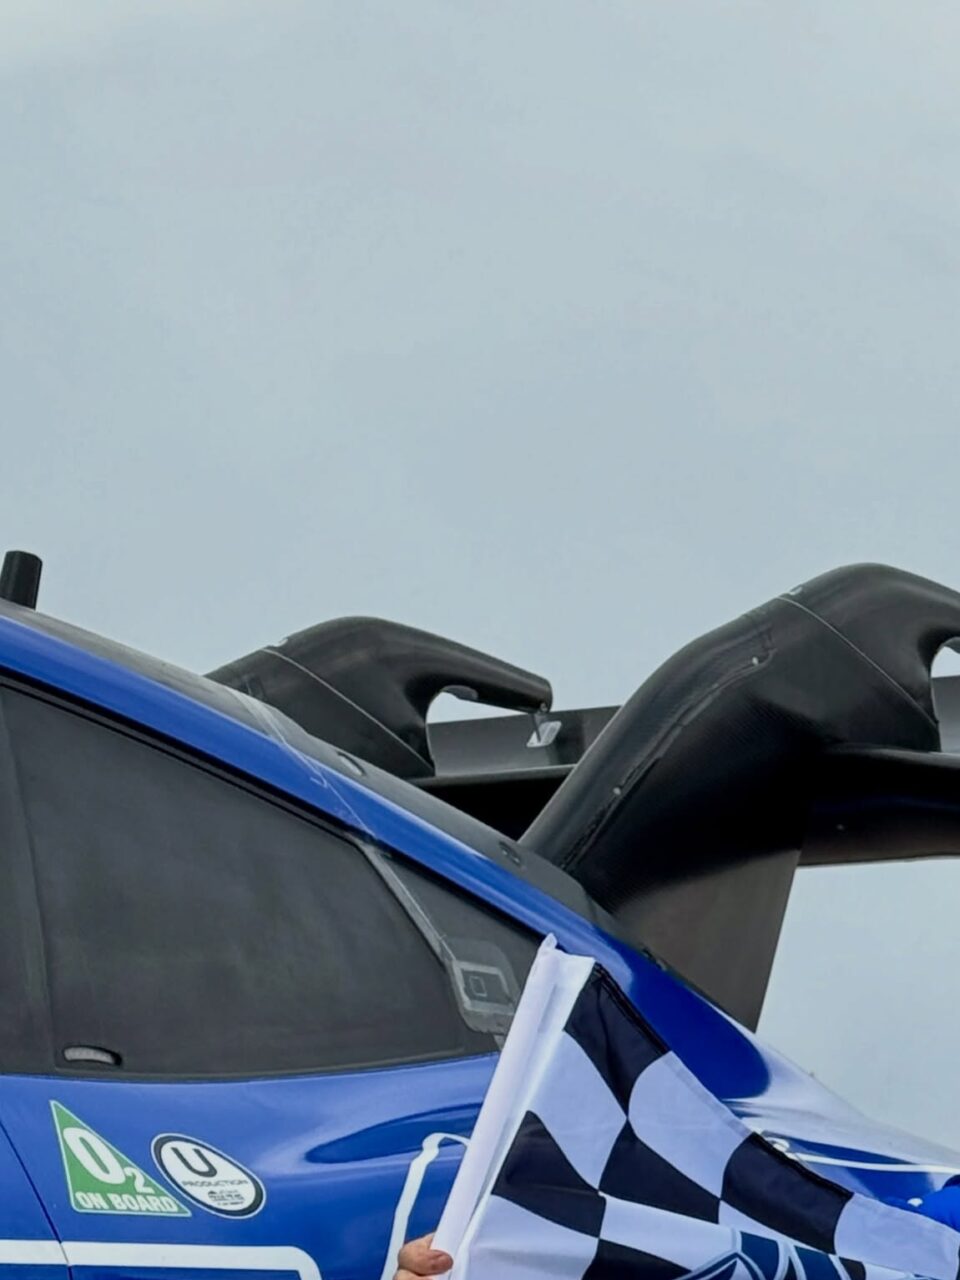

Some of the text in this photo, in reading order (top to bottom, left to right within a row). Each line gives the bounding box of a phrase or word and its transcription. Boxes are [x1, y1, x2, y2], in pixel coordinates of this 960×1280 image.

[169, 1146, 218, 1178] U
[181, 1179, 249, 1189] PRODUCTION
[75, 1191, 179, 1212] ON BOARD
